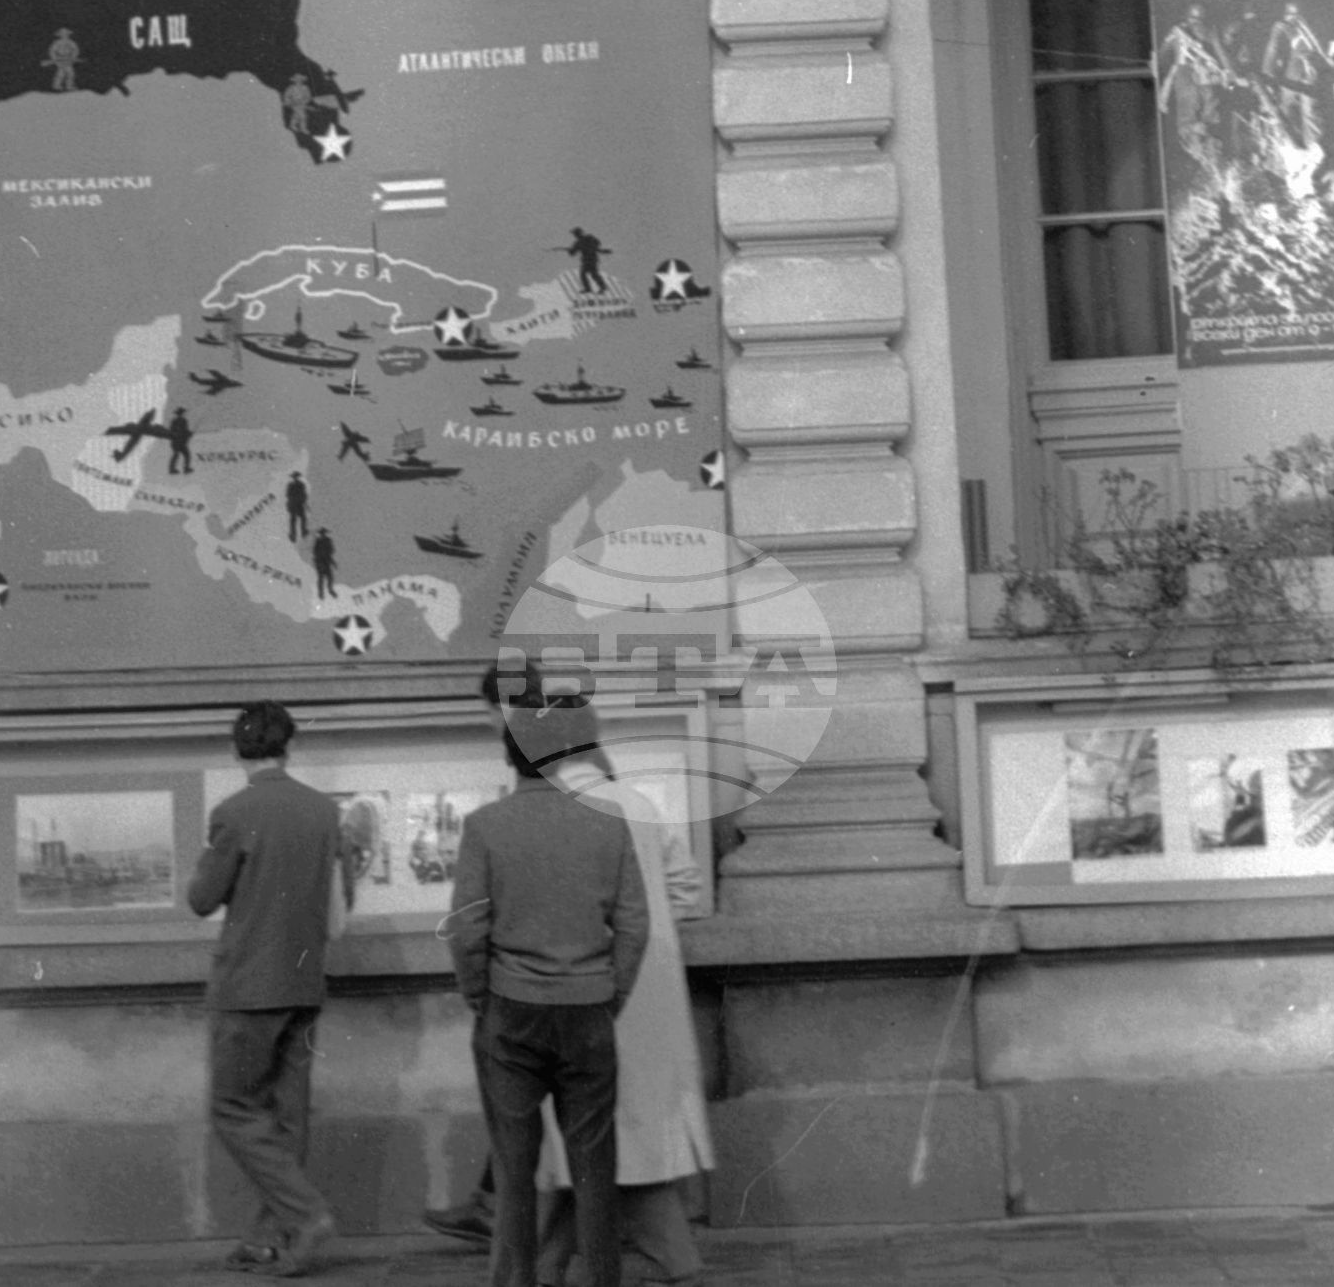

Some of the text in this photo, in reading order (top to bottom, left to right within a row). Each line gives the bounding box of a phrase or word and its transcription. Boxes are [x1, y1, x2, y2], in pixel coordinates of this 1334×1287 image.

[130, 14, 191, 48] САЩ
[398, 41, 599, 72] АТЛАНТИЧЕСКИ ОКЕАН
[307, 259, 391, 283] КУБА
[442, 417, 689, 448] КАРАИБСКО МОРЕ
